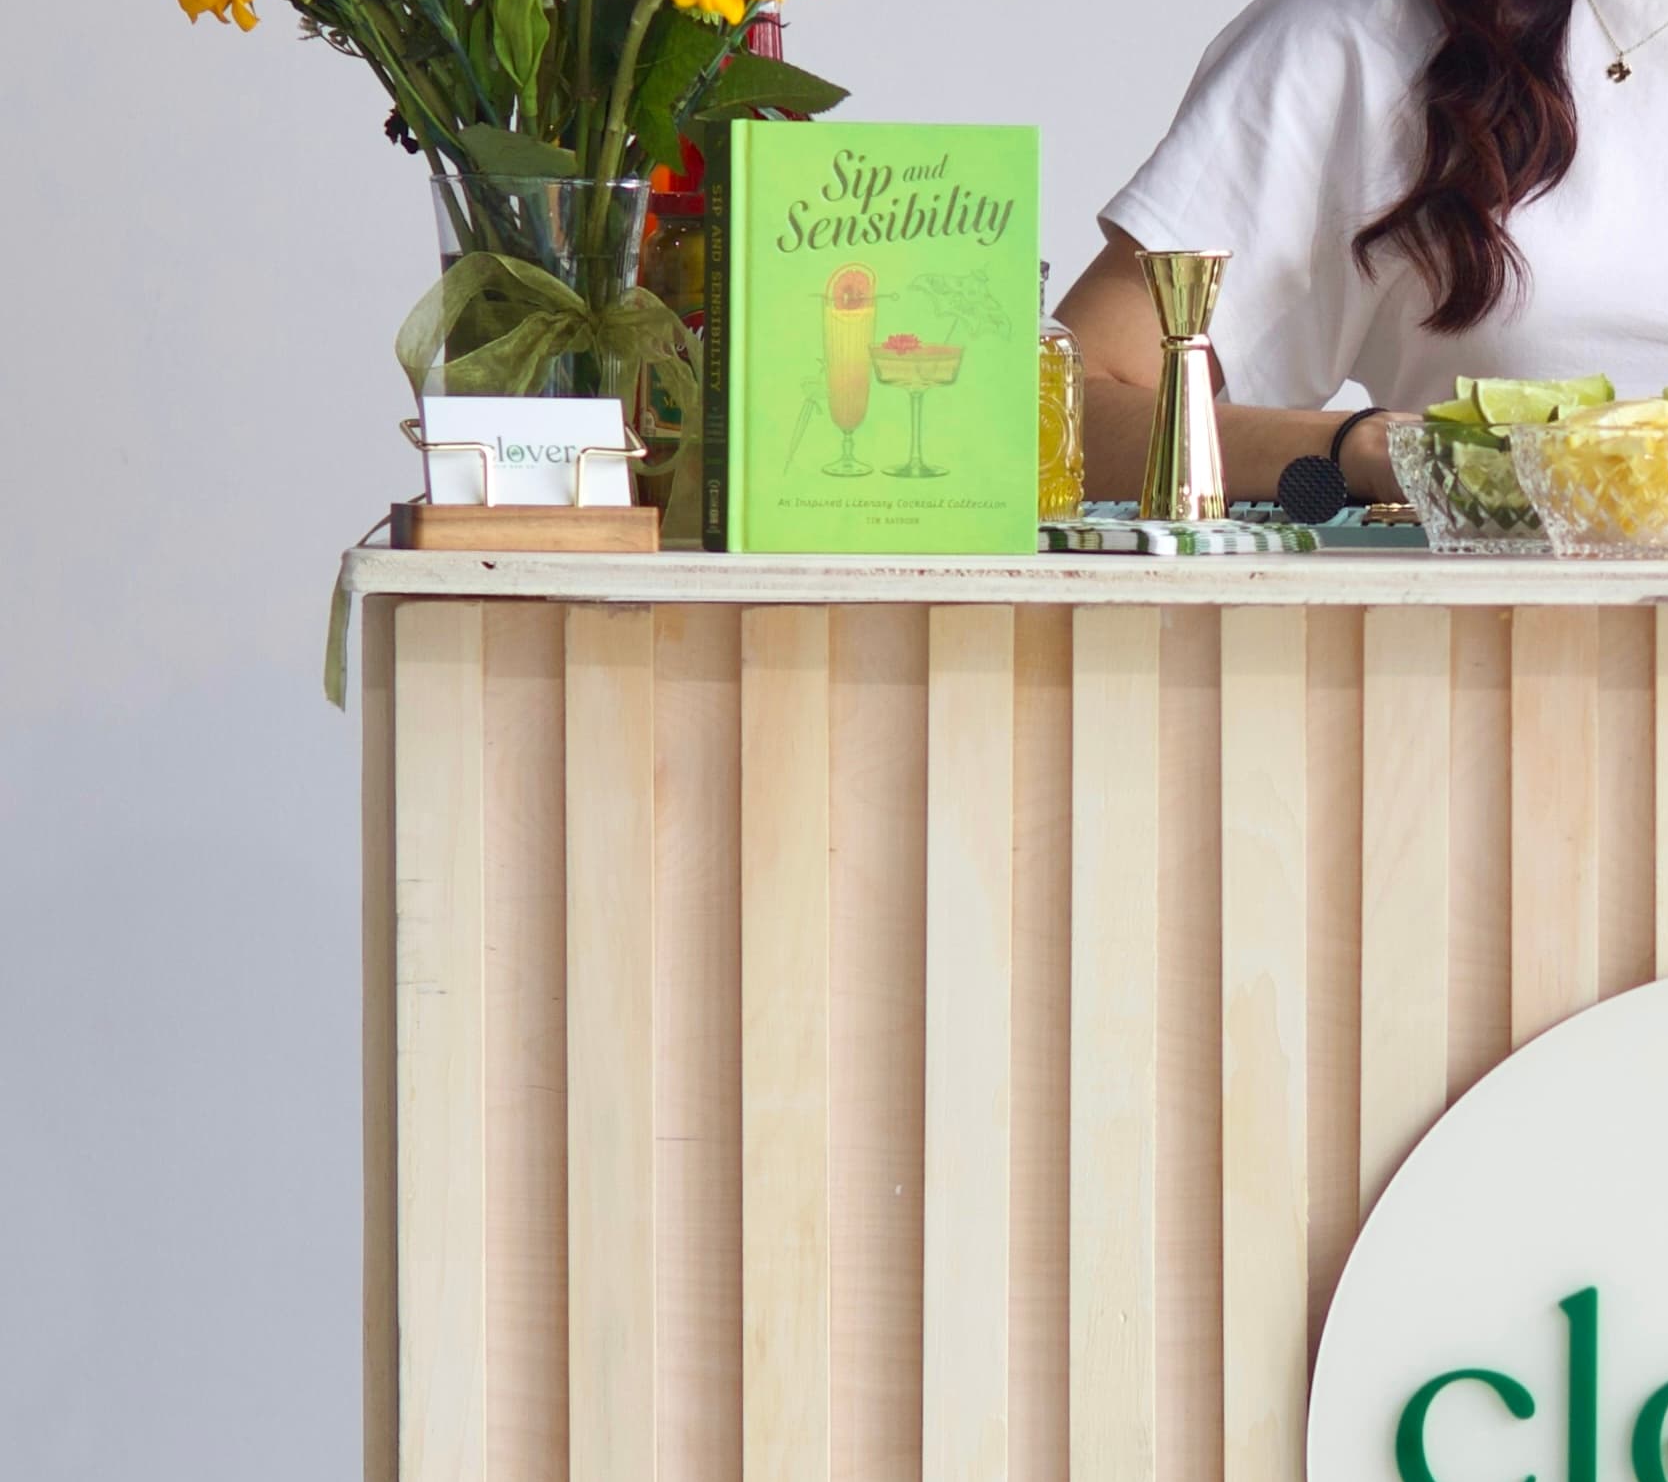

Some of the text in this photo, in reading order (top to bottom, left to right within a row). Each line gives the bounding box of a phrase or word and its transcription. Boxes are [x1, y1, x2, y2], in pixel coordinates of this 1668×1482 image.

[822, 149, 948, 214] Sip and
[777, 185, 1014, 253] Sensibility
[710, 184, 722, 391] SIP AND SENSIBILITY
[485, 436, 577, 463] lover
[778, 498, 1007, 510] An Inspired Literary Cocktail Collection
